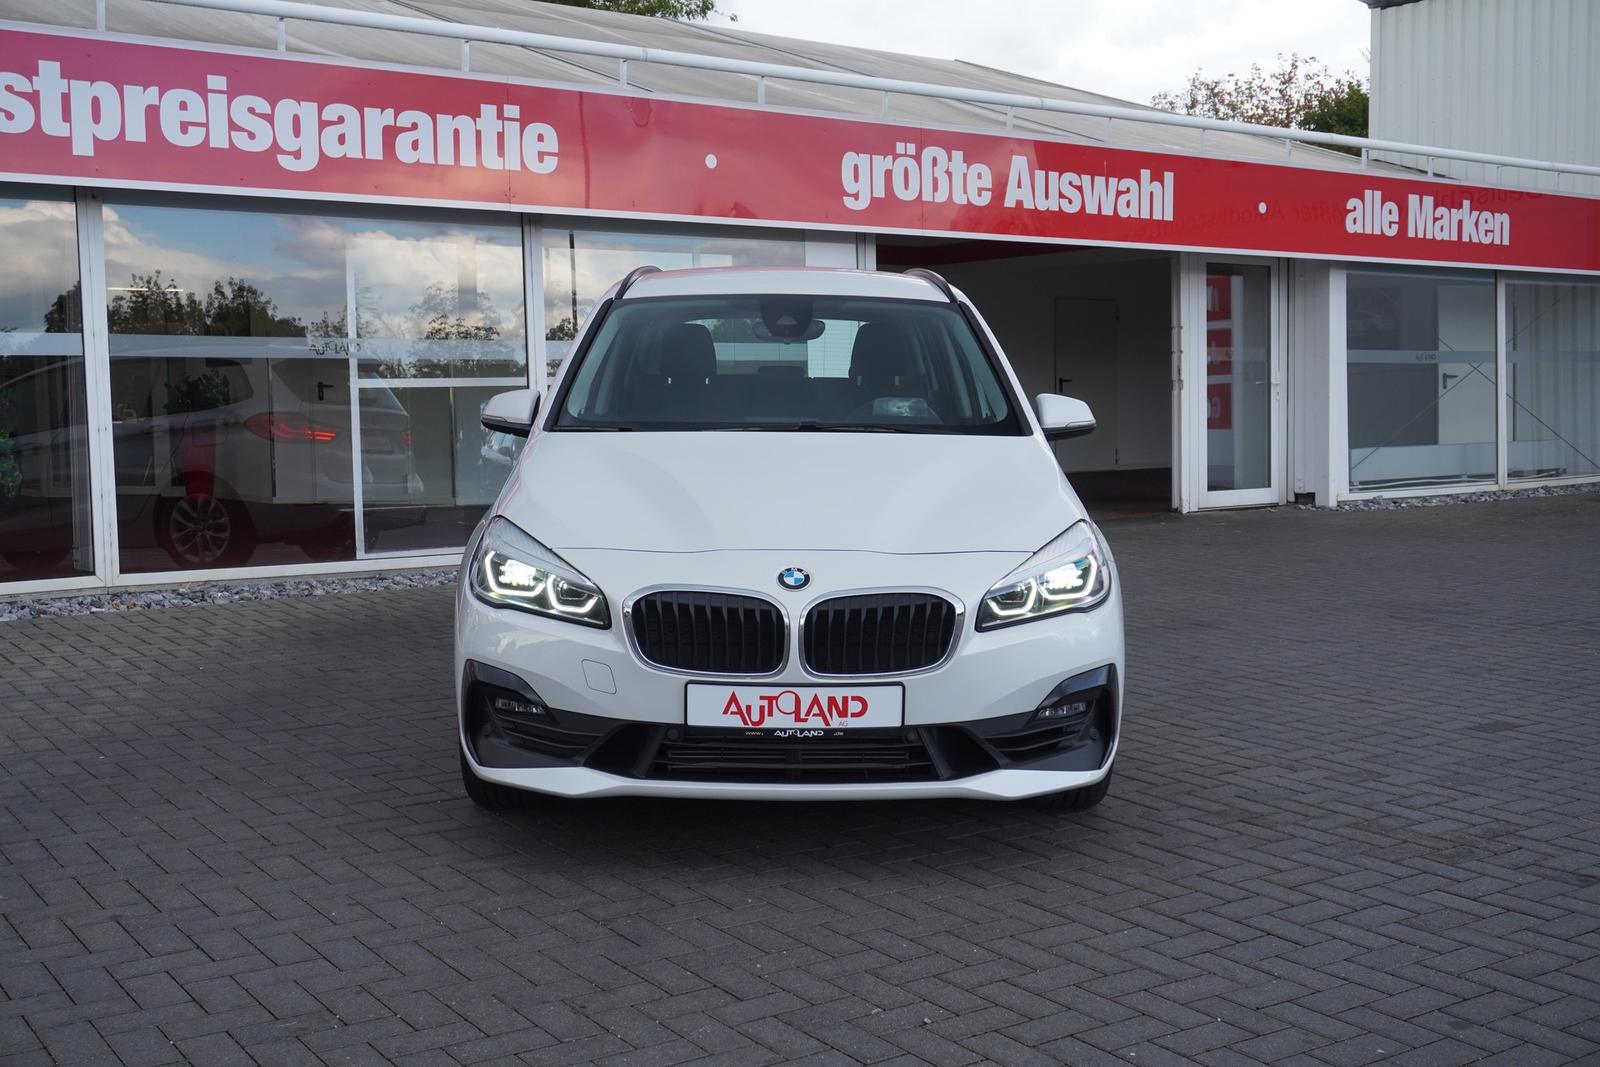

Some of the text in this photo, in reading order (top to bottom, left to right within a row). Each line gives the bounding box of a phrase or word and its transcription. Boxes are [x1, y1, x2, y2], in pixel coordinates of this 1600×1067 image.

[841, 142, 992, 211] größte
[1004, 155, 1175, 221] Auswahl
[1346, 189, 1399, 237] alle
[1407, 194, 1510, 246] Marken
[722, 690, 868, 727] AUTOLAND
[774, 729, 824, 738] AUTOLAND
